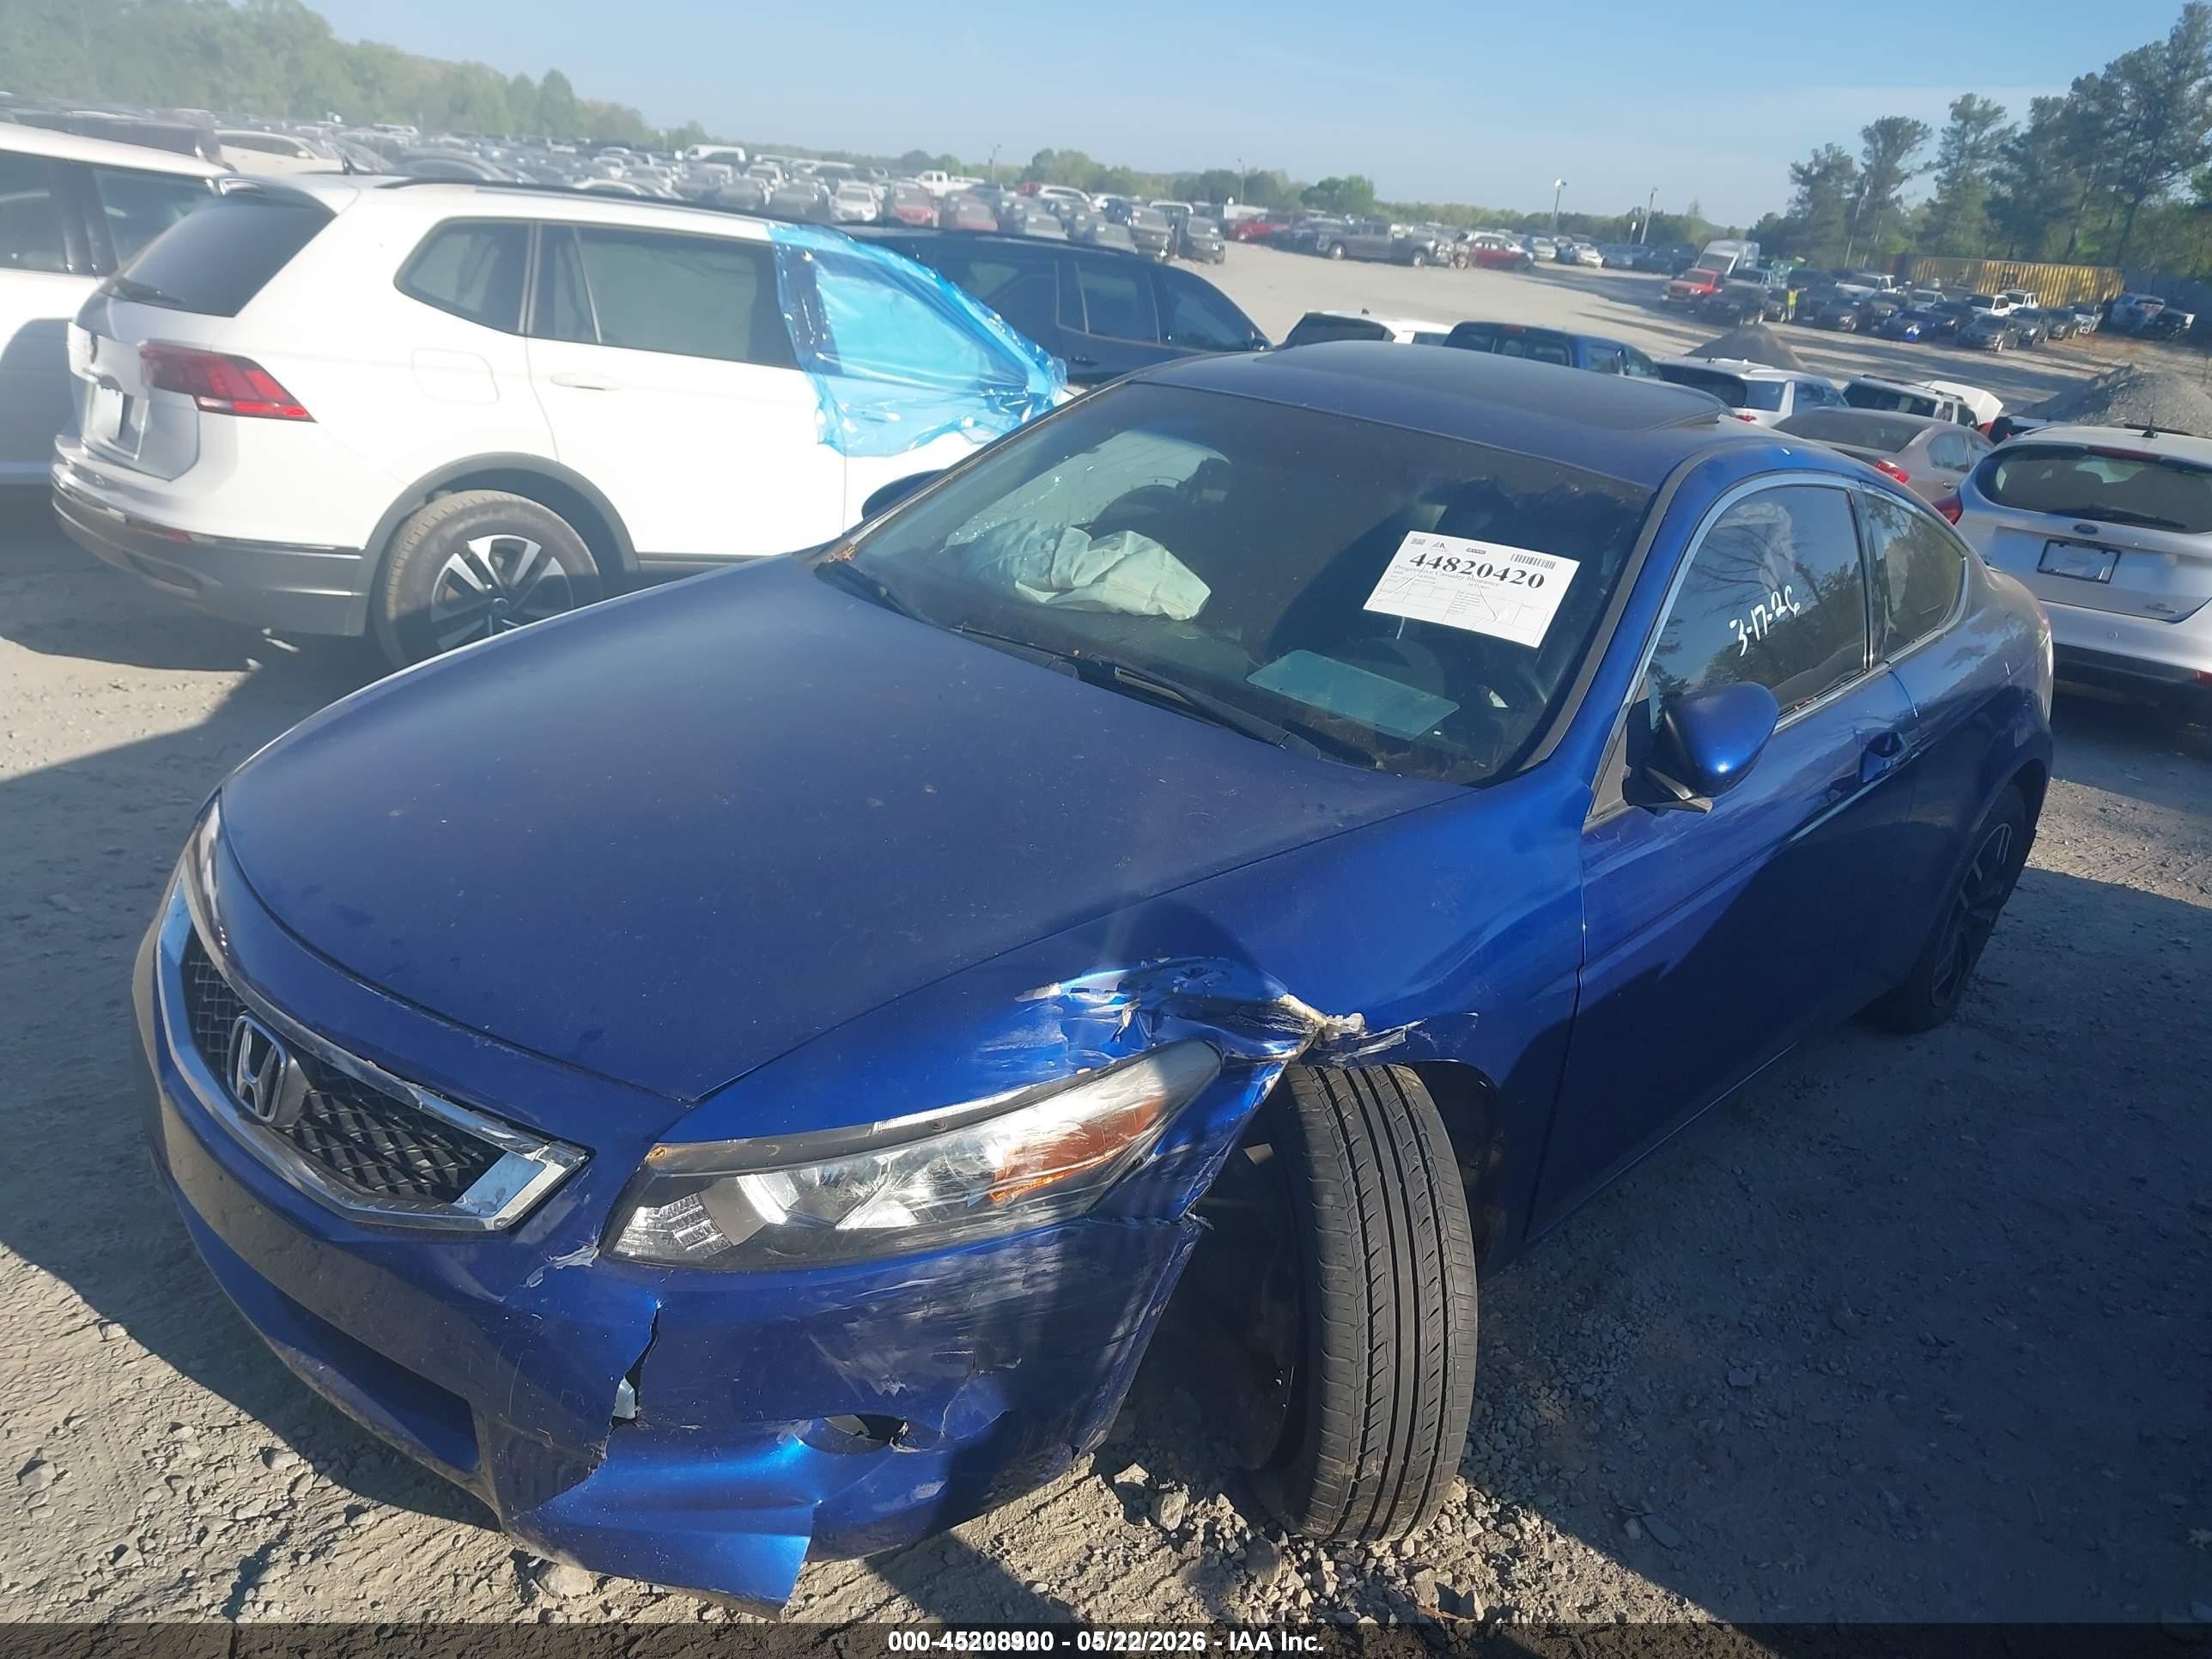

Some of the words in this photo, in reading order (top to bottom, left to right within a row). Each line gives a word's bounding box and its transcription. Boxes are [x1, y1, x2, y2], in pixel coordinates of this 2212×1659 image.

[1395, 563, 1434, 575] Progressive
[1435, 569, 1465, 580] Casualty
[1467, 575, 1501, 586] Insurance
[1409, 553, 1545, 589] 44820420
